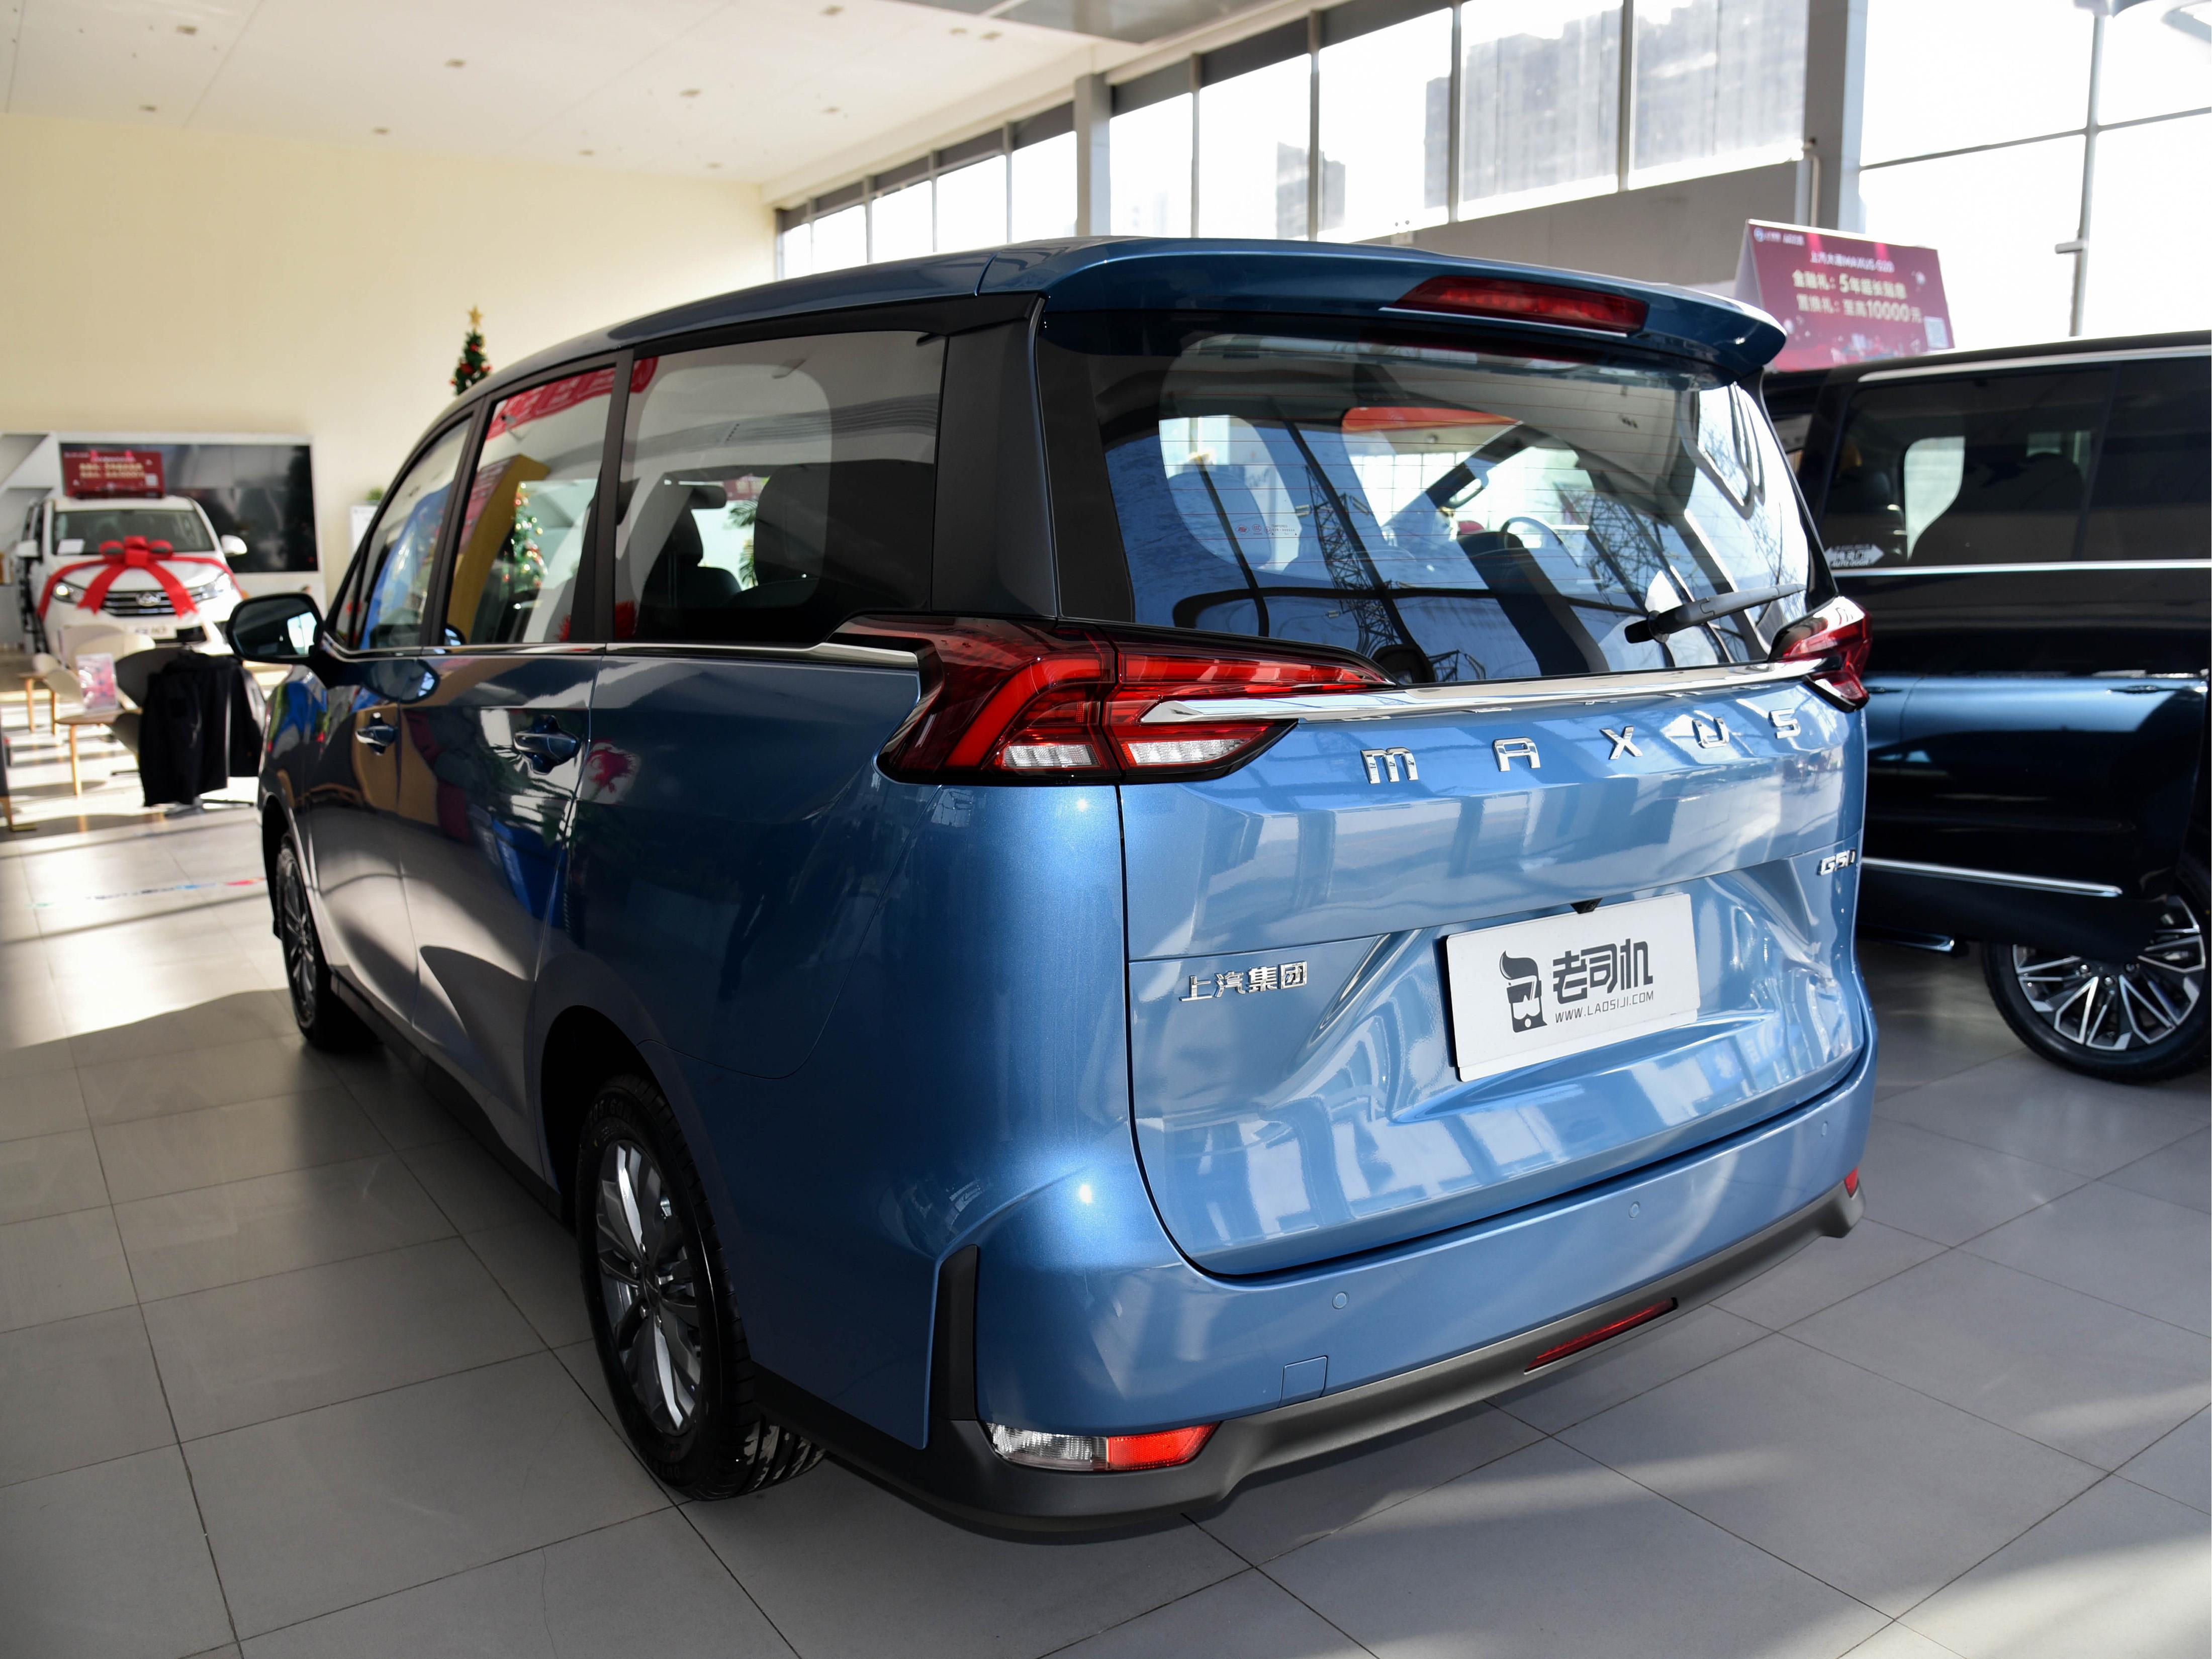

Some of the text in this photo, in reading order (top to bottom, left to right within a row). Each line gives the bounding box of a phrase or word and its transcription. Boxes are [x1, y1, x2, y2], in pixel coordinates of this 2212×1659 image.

[1360, 708, 1801, 784] MAXUS
[1179, 961, 1307, 1001] 上汽集团
[1553, 938, 1653, 1004] 老司机
[1555, 990, 1653, 1023] WWW.LAOSIJI.COM
